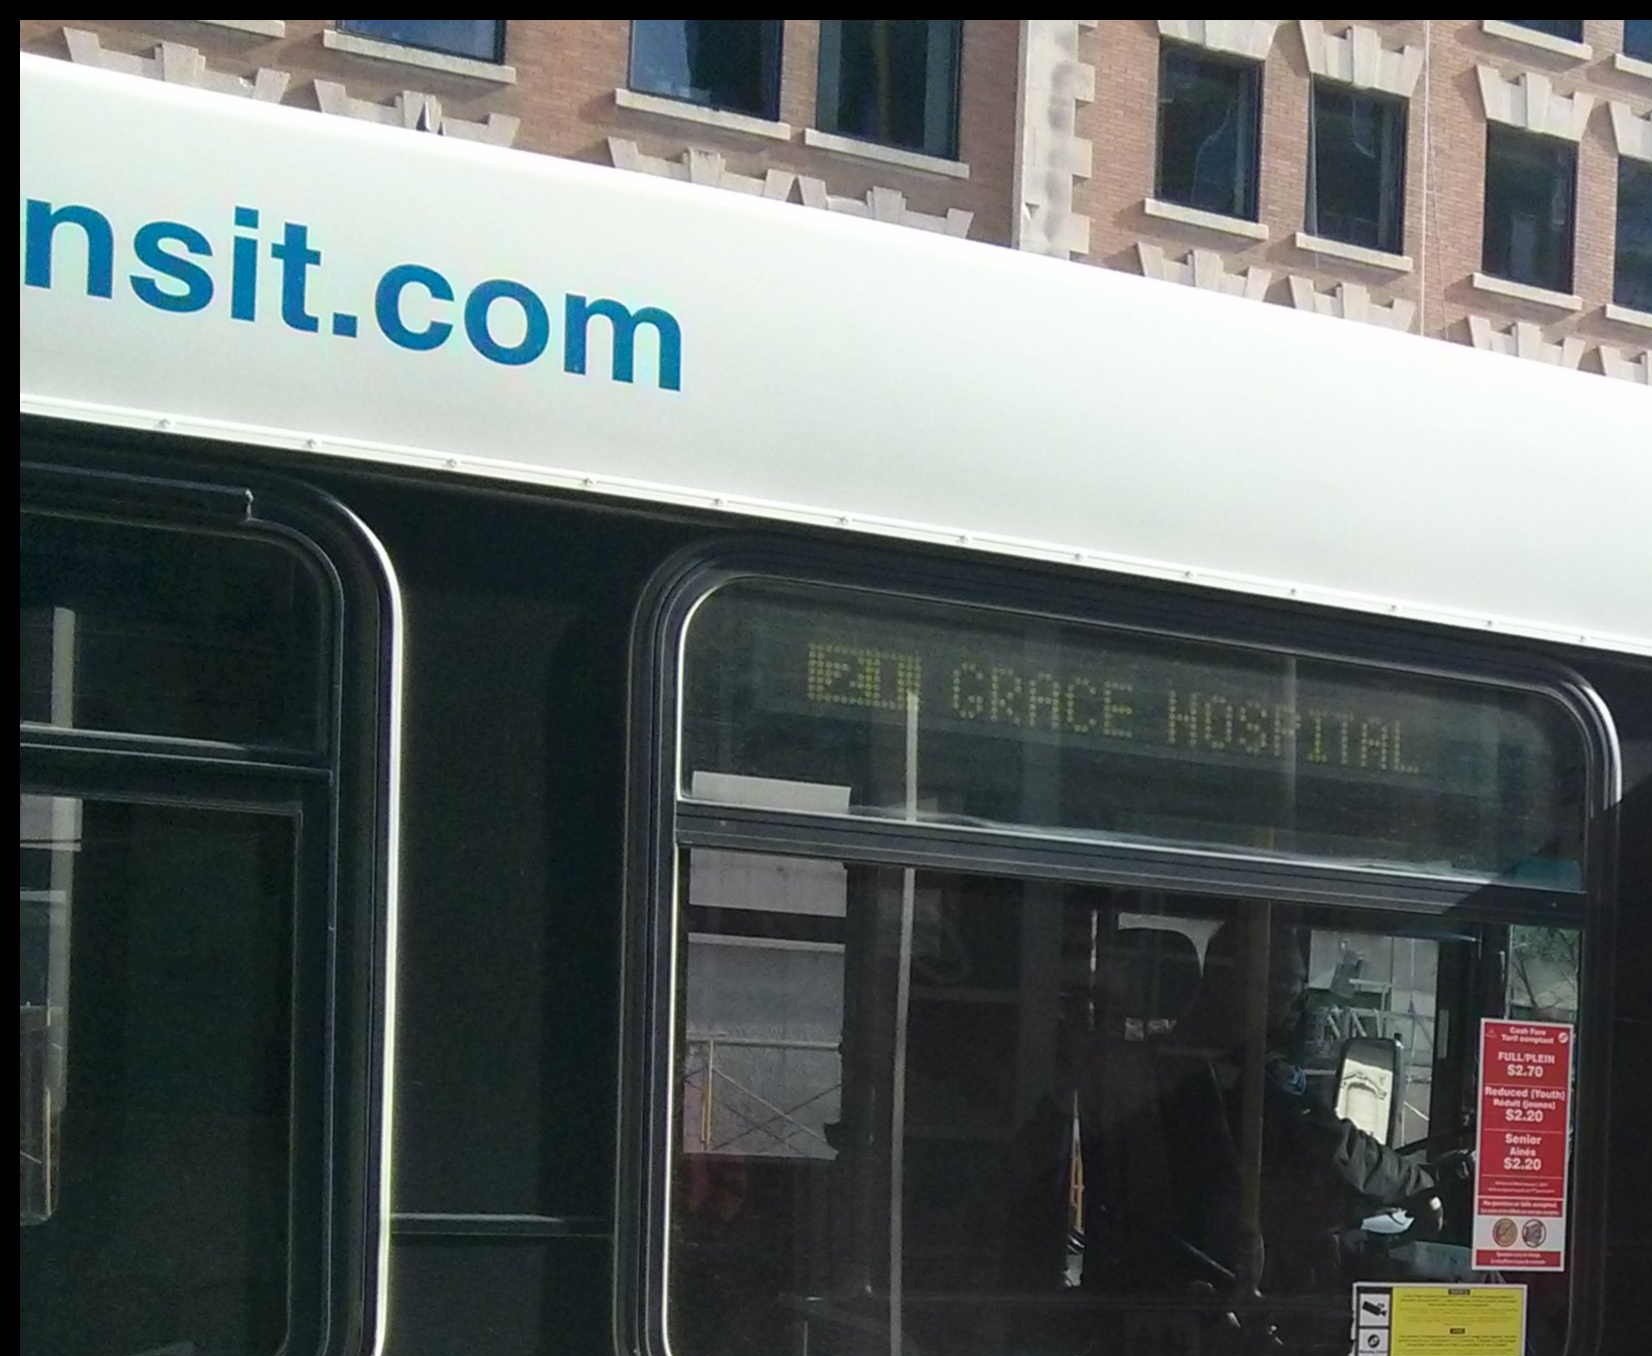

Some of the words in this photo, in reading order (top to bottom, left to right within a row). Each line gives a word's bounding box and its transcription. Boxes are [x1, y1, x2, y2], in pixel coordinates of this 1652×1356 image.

[24, 198, 684, 393] nsit.com
[951, 660, 1134, 739] GRACE
[1167, 689, 1420, 775] HOSPITAL
[1498, 1051, 1556, 1064] FULL/PLEIN
[1507, 1064, 1544, 1078] $2.70
[1485, 1086, 1529, 1098] Reduced
[1531, 1089, 1566, 1101] (Youth)
[1505, 1108, 1544, 1122] $2.20
[1505, 1133, 1542, 1145] Senior
[1503, 1156, 1542, 1171] $2.20
